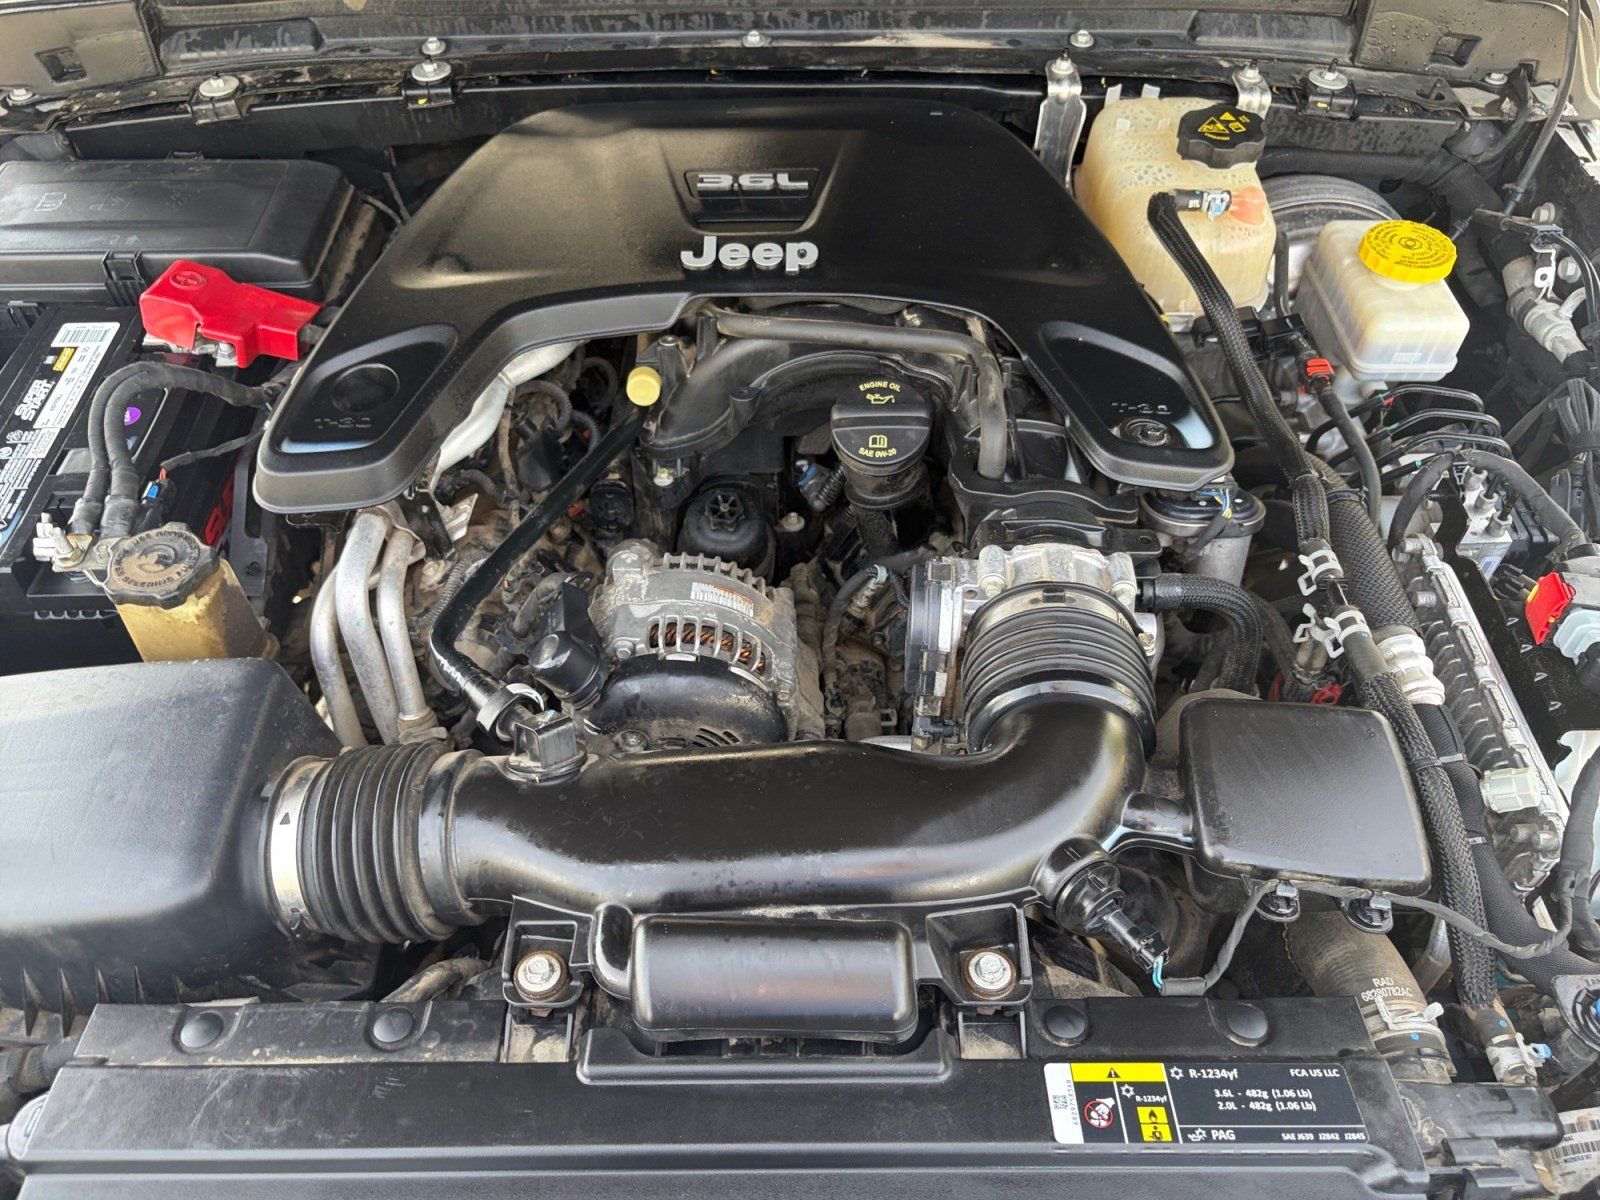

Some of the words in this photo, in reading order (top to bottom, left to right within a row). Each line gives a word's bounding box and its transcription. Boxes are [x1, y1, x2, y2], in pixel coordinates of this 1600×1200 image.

[697, 172, 809, 191] 3.6L
[680, 235, 819, 275] Jeep
[858, 381, 889, 391] ENGINE
[889, 382, 901, 392] OIL
[14, 379, 47, 416] SUPER
[20, 380, 56, 421] START
[858, 447, 874, 458] SAE
[875, 447, 897, 458] 0W-20
[1372, 976, 1395, 987] RAD
[1188, 1068, 1239, 1081] R-1234yf
[1289, 1068, 1309, 1077] FCA
[1309, 1068, 1323, 1077] US
[1323, 1069, 1341, 1077] LLC
[1135, 1095, 1168, 1104] R-1234yf
[1213, 1088, 1235, 1098] 3.6L
[1245, 1088, 1270, 1100] 482g
[1271, 1088, 1296, 1100] (1.06
[1296, 1088, 1313, 1100] Lb)
[1217, 1101, 1239, 1111] 2.0L
[1249, 1101, 1273, 1112] 482g
[1275, 1101, 1300, 1112] (1.06
[1300, 1101, 1317, 1112] Lb)
[1210, 1129, 1236, 1141] PAG
[1281, 1132, 1297, 1141] SAE
